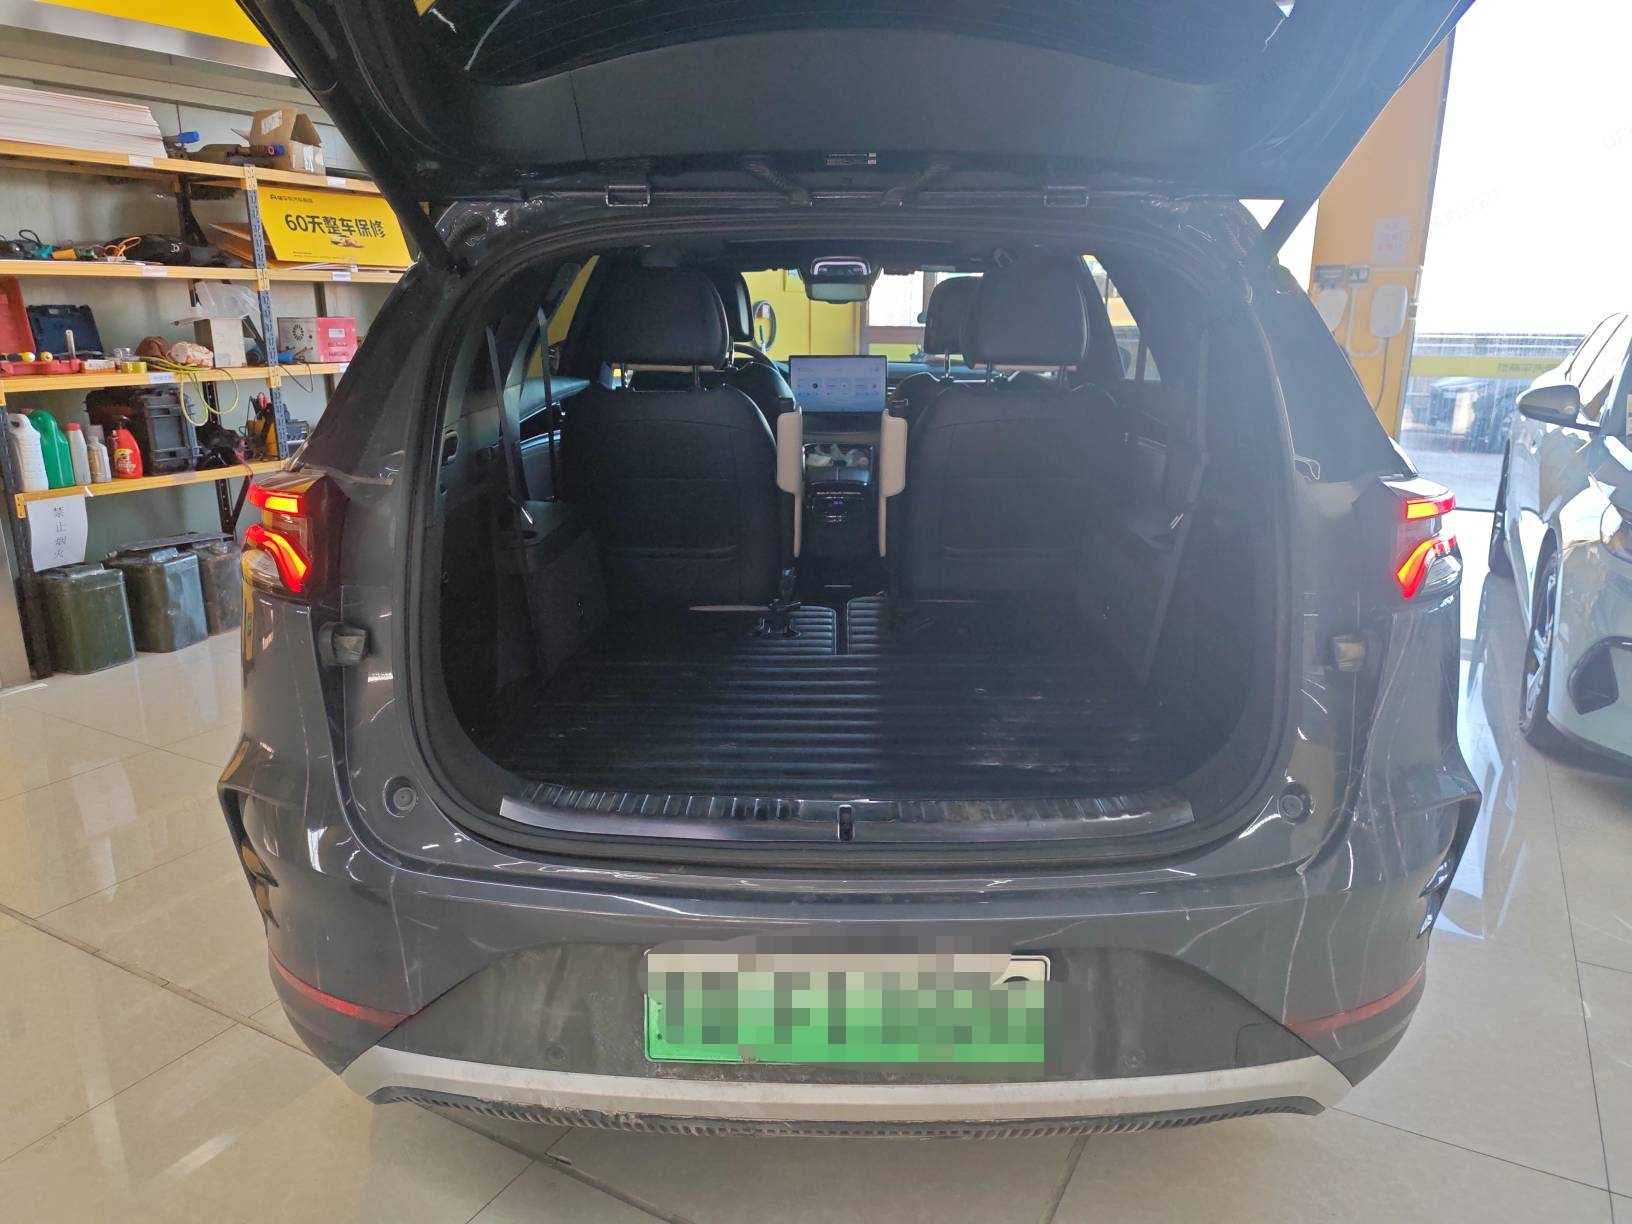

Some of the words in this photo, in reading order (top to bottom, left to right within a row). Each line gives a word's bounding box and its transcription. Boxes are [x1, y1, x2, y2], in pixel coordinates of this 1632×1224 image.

[285, 214, 386, 238] 60天整车保修
